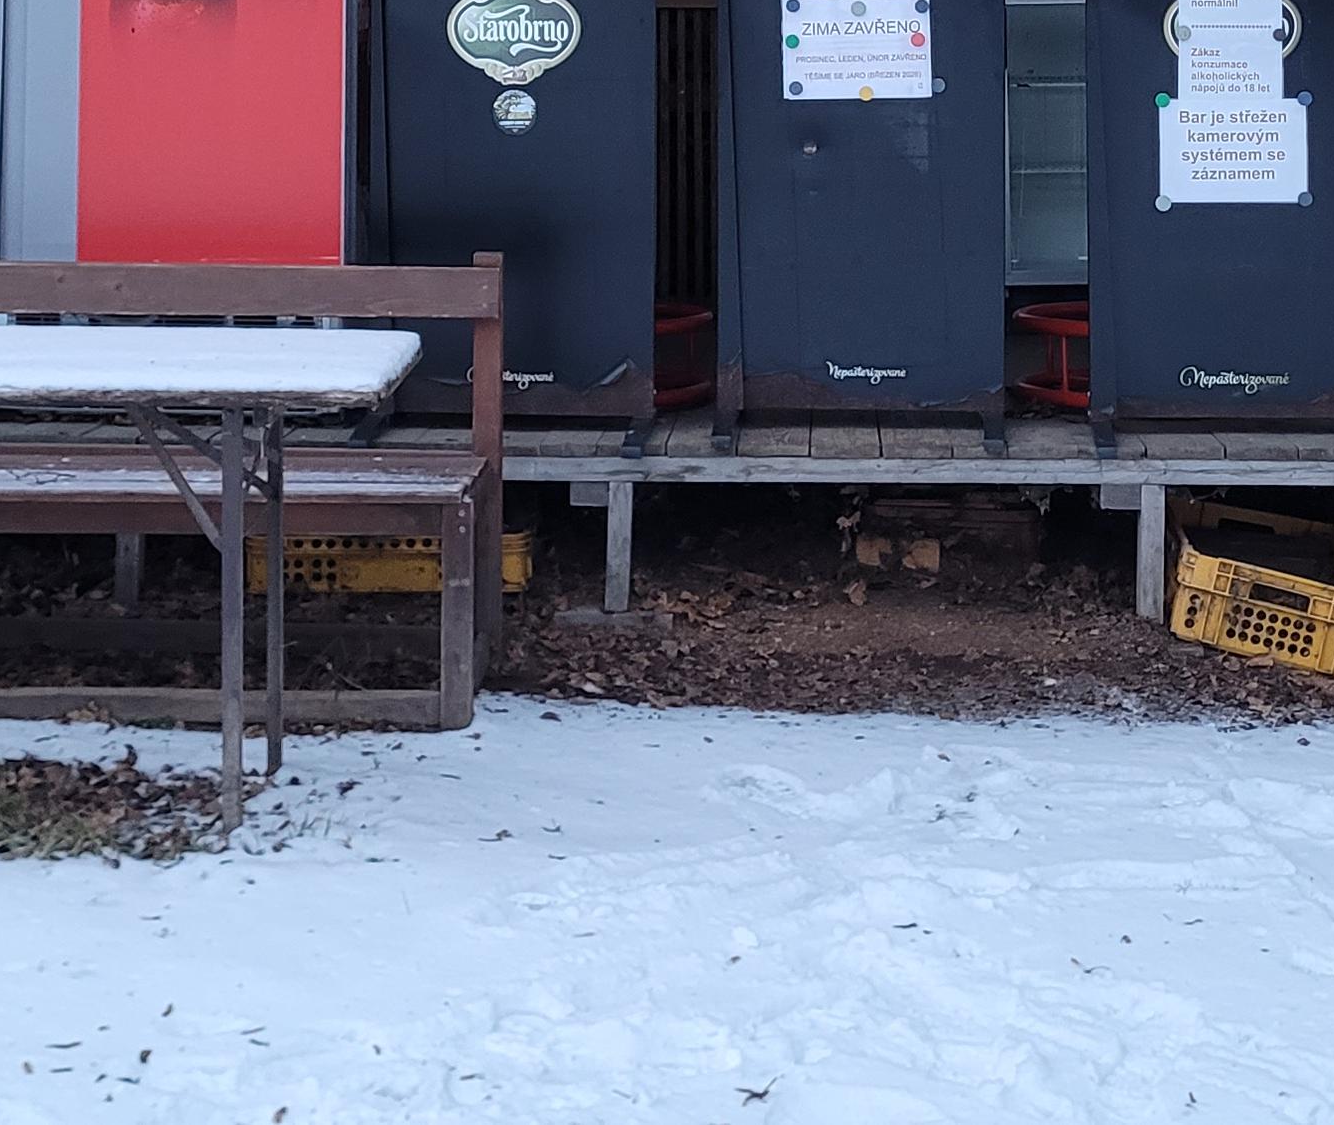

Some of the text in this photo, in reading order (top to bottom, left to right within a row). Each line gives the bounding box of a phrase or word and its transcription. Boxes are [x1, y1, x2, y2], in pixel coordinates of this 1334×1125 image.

[463, 4, 569, 57] Starobrno
[801, 18, 921, 36] ZIMA ZAVŘENO
[1191, 47, 1221, 57] Zákaz
[1191, 60, 1248, 69] konzumace
[1191, 71, 1260, 82] alkoholických
[1191, 83, 1271, 94] nápojů do 18 let
[1179, 109, 1287, 126] Bar je střežen
[1187, 128, 1279, 145] kamerovým
[1181, 147, 1286, 164] systémem se
[1191, 166, 1276, 181] záznamem
